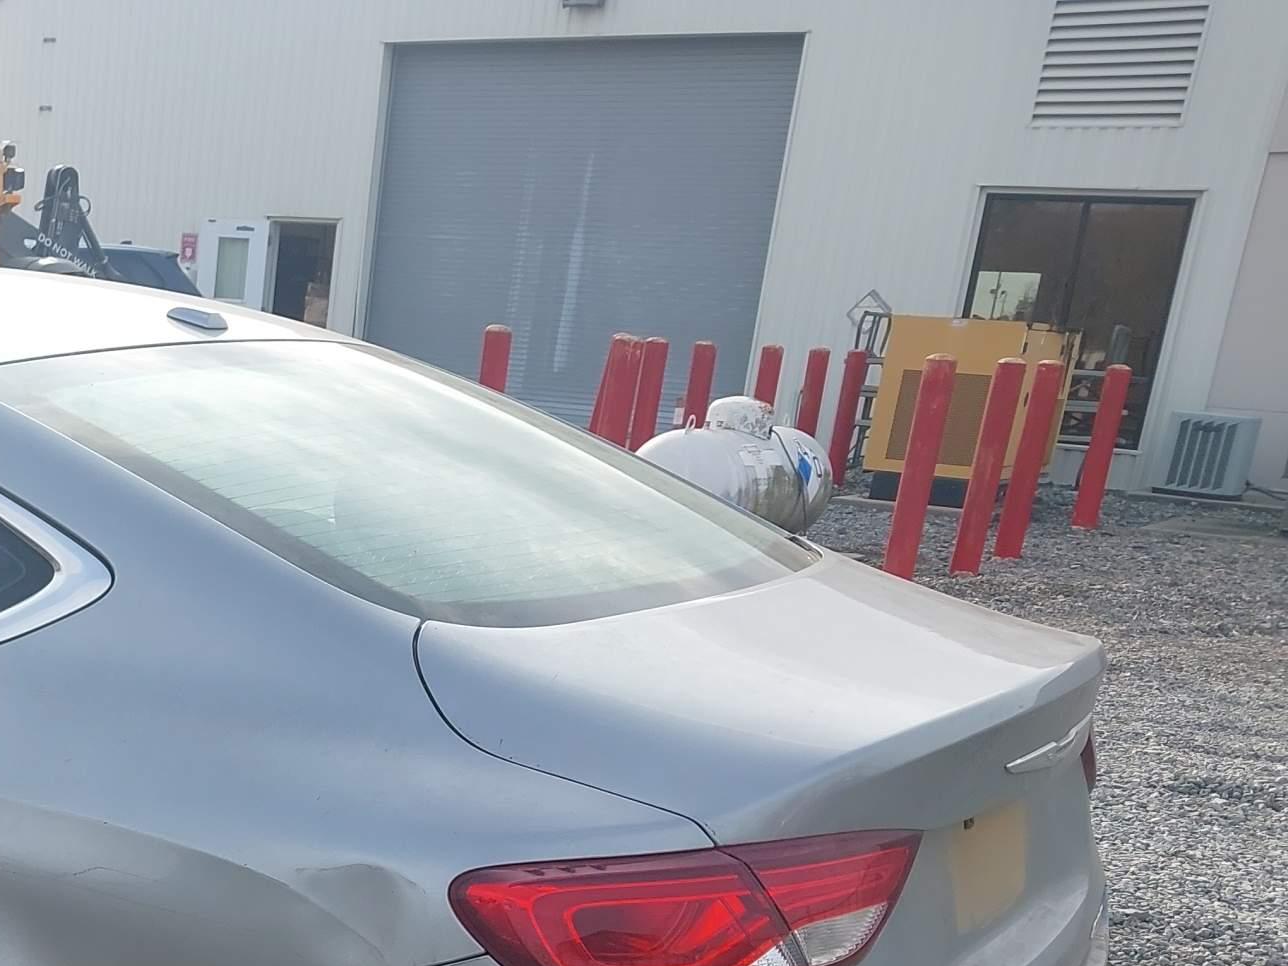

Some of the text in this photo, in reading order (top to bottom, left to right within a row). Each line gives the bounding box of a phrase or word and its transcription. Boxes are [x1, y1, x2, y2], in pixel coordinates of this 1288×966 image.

[38, 232, 97, 278] DO NOT WALK
